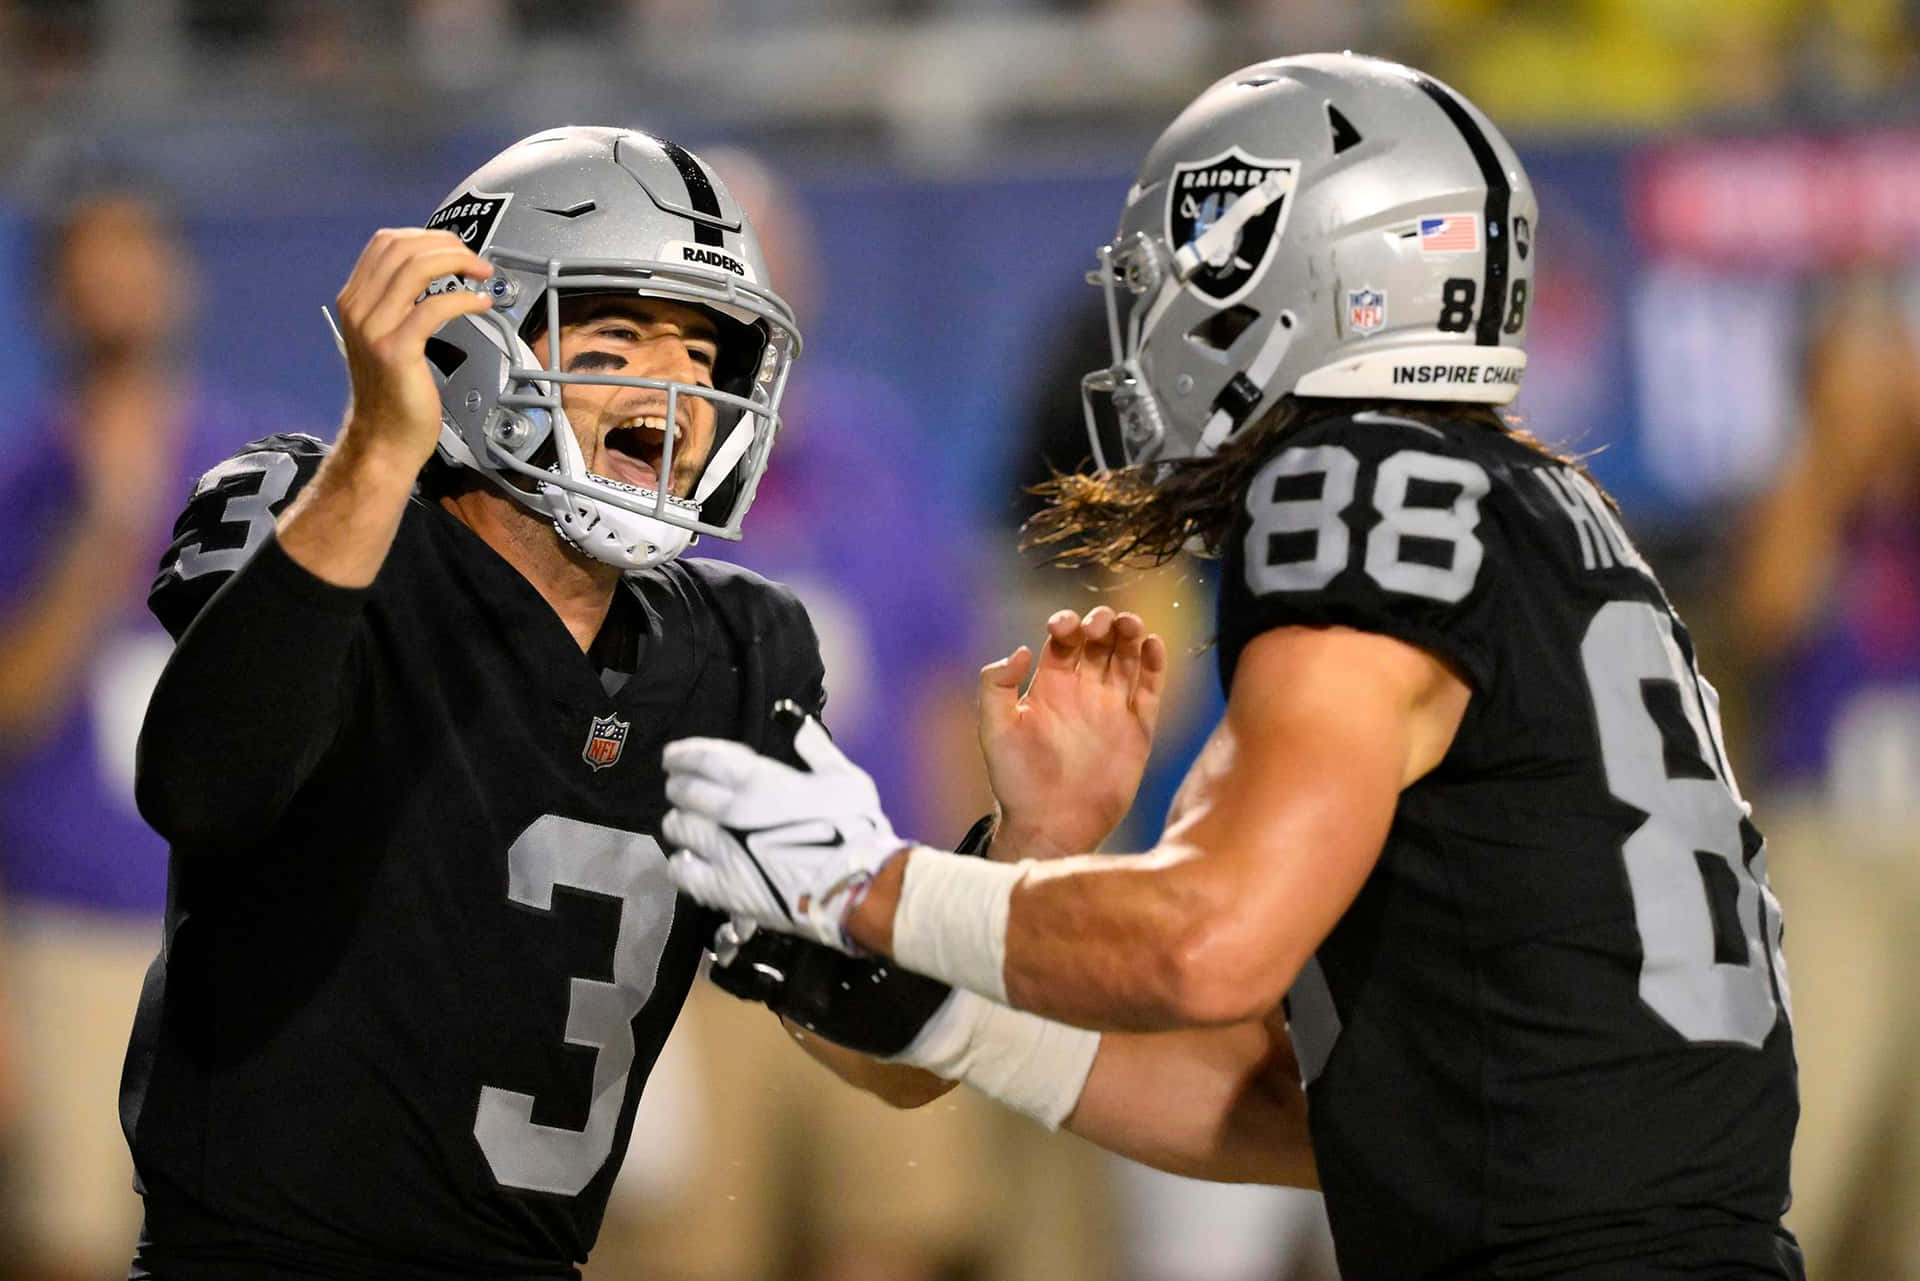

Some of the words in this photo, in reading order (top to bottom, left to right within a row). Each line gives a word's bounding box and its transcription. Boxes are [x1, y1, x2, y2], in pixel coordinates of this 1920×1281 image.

[430, 202, 493, 227] RAIDERS
[683, 247, 744, 276] RAIDERS
[1353, 307, 1382, 327] NFL
[1394, 367, 1479, 383] INSPIRE
[175, 451, 298, 580] 3
[1244, 445, 1491, 605] 88
[588, 739, 620, 762] NFL
[473, 814, 677, 1197] 3
